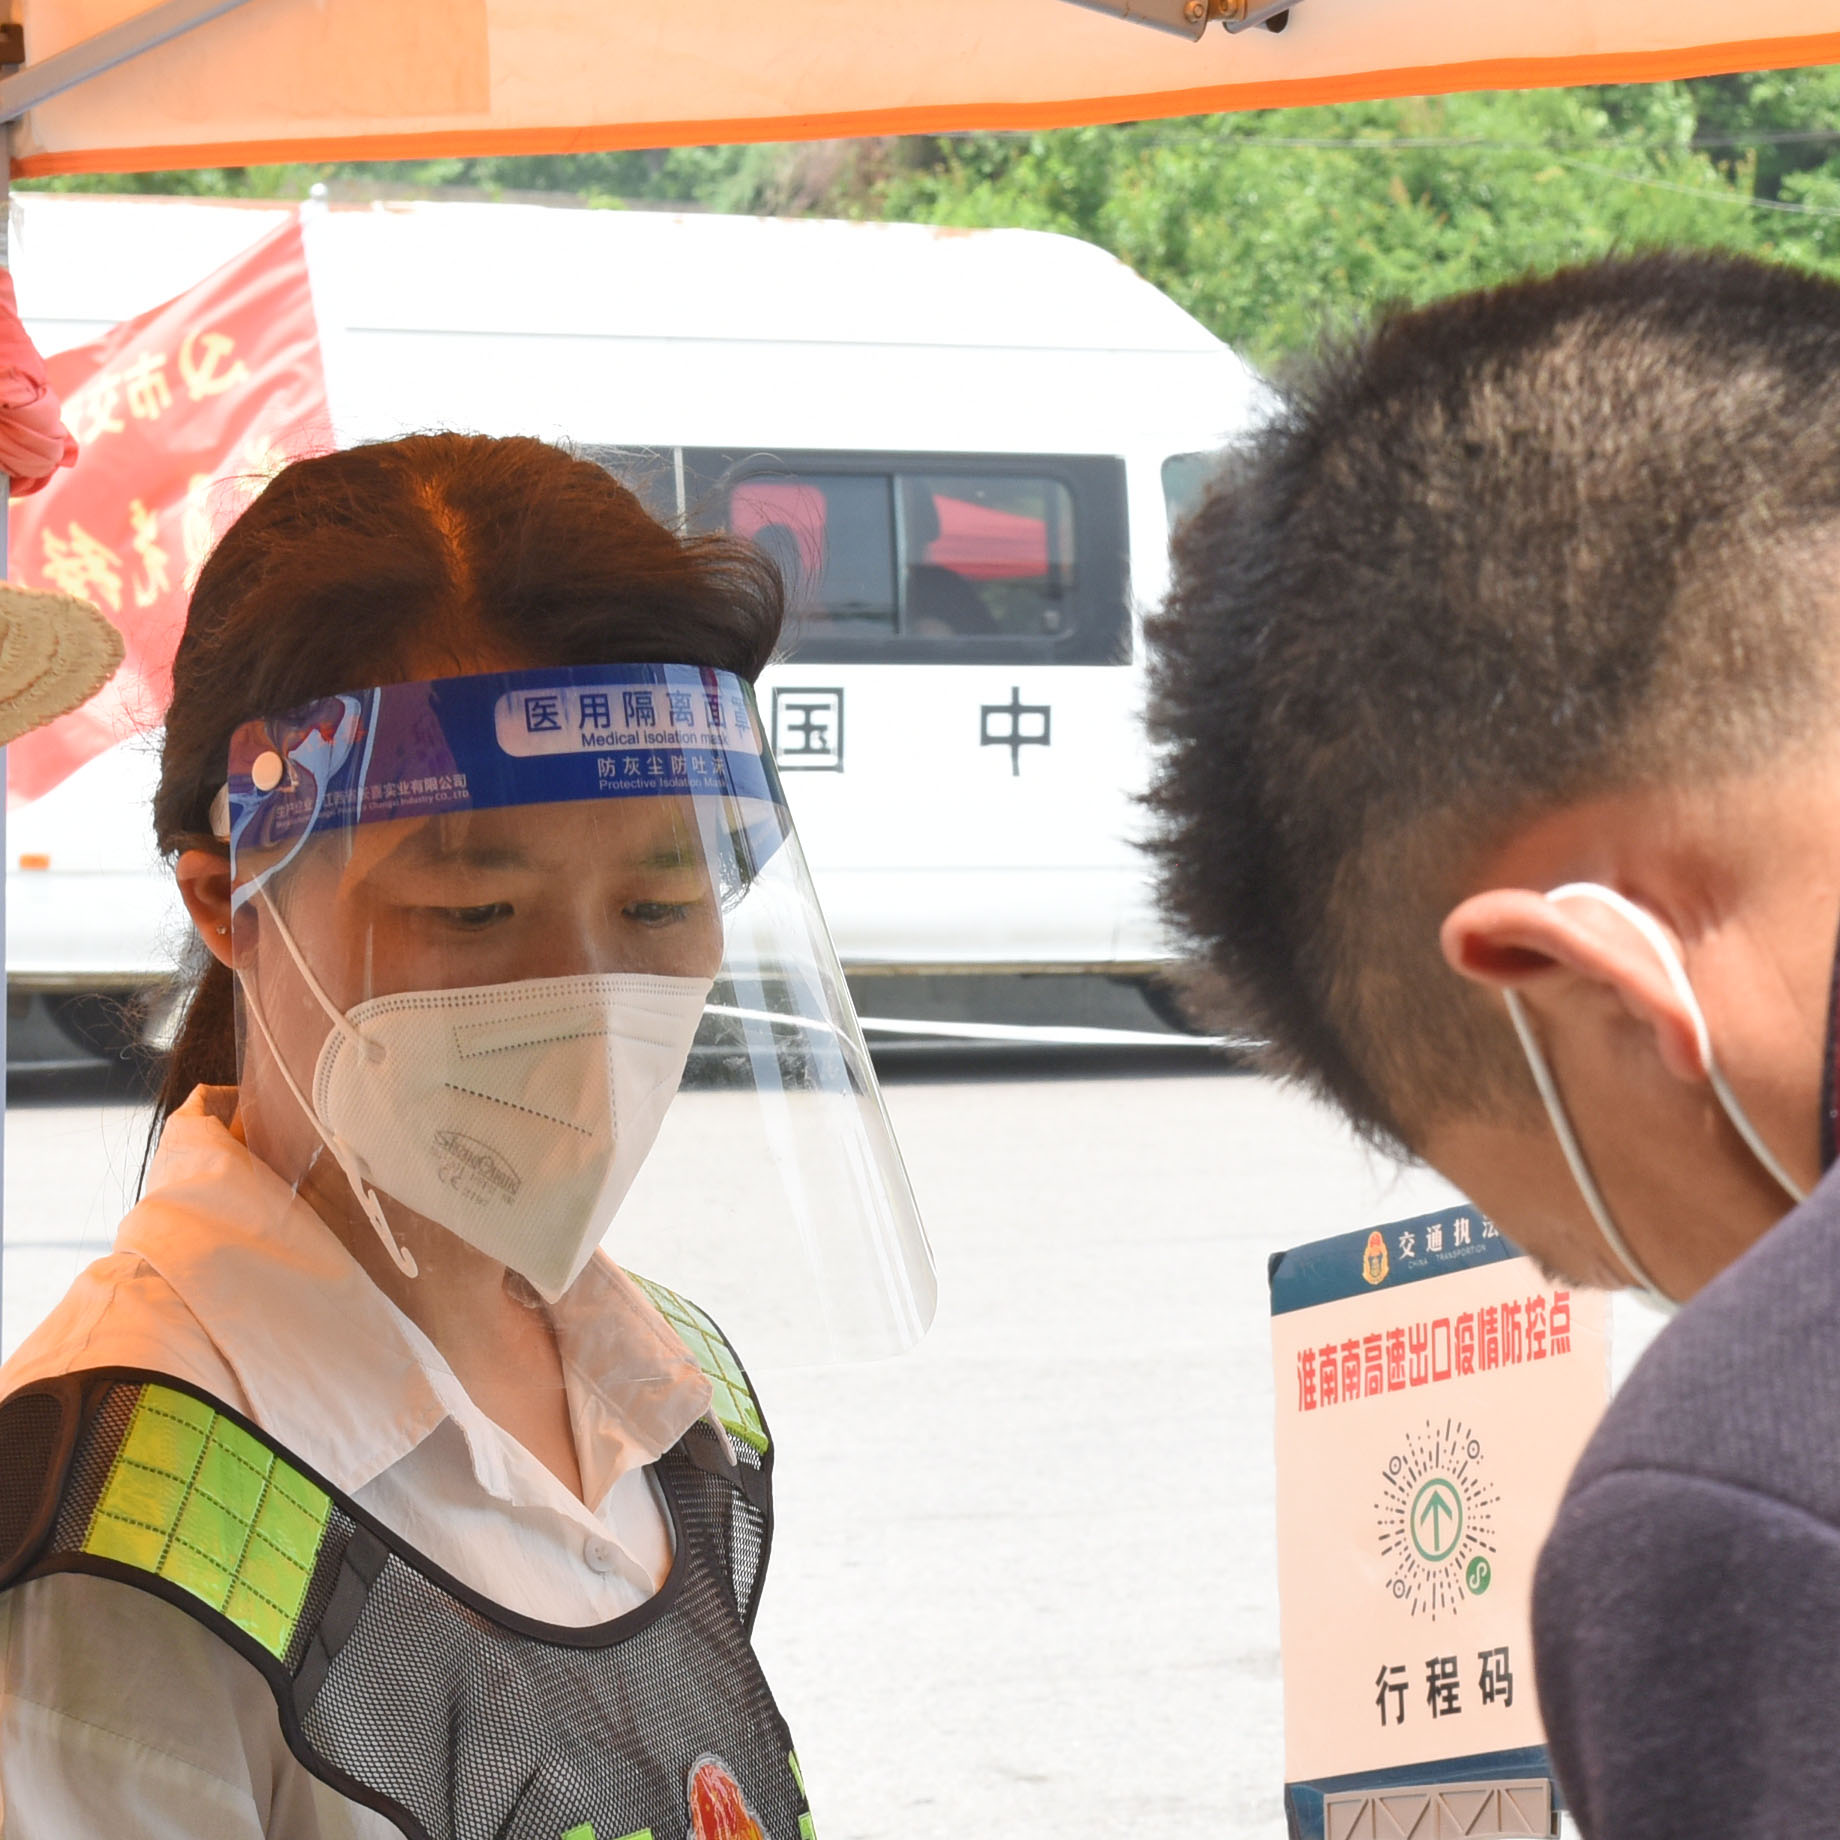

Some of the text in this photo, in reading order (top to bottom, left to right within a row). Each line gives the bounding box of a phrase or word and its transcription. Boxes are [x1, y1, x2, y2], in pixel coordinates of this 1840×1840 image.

[523, 688, 751, 736] 医用隔离面罩
[580, 730, 640, 748] Medical
[596, 755, 726, 778] 防灰尘防吐沫
[599, 777, 657, 791] Protective
[1296, 1289, 1572, 1413] 淮南南高速出口疫情防控点
[1374, 1646, 1514, 1727] 行程码
